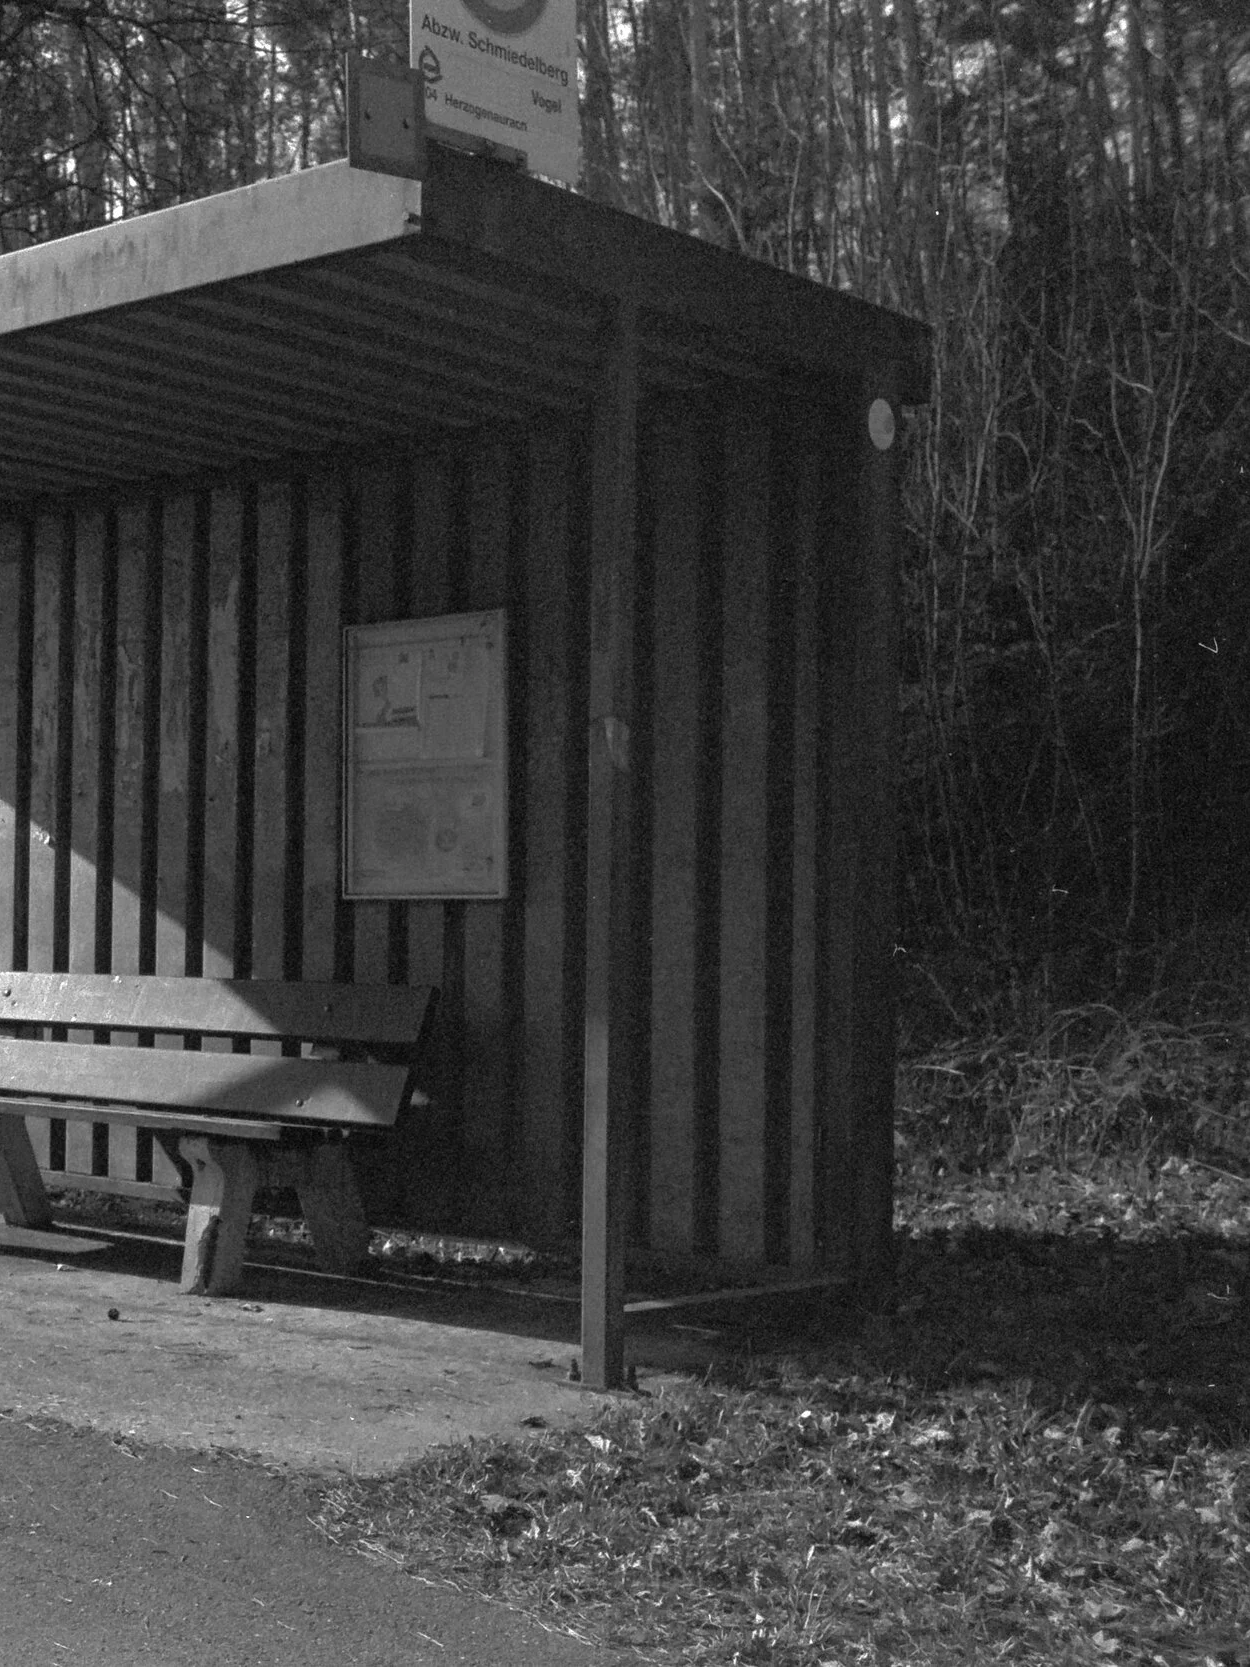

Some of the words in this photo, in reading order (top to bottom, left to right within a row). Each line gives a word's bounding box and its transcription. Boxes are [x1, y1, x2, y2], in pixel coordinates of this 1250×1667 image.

[421, 14, 464, 45] Abzw.
[468, 31, 569, 87] Schmiedelberg
[531, 89, 562, 114] Vogel
